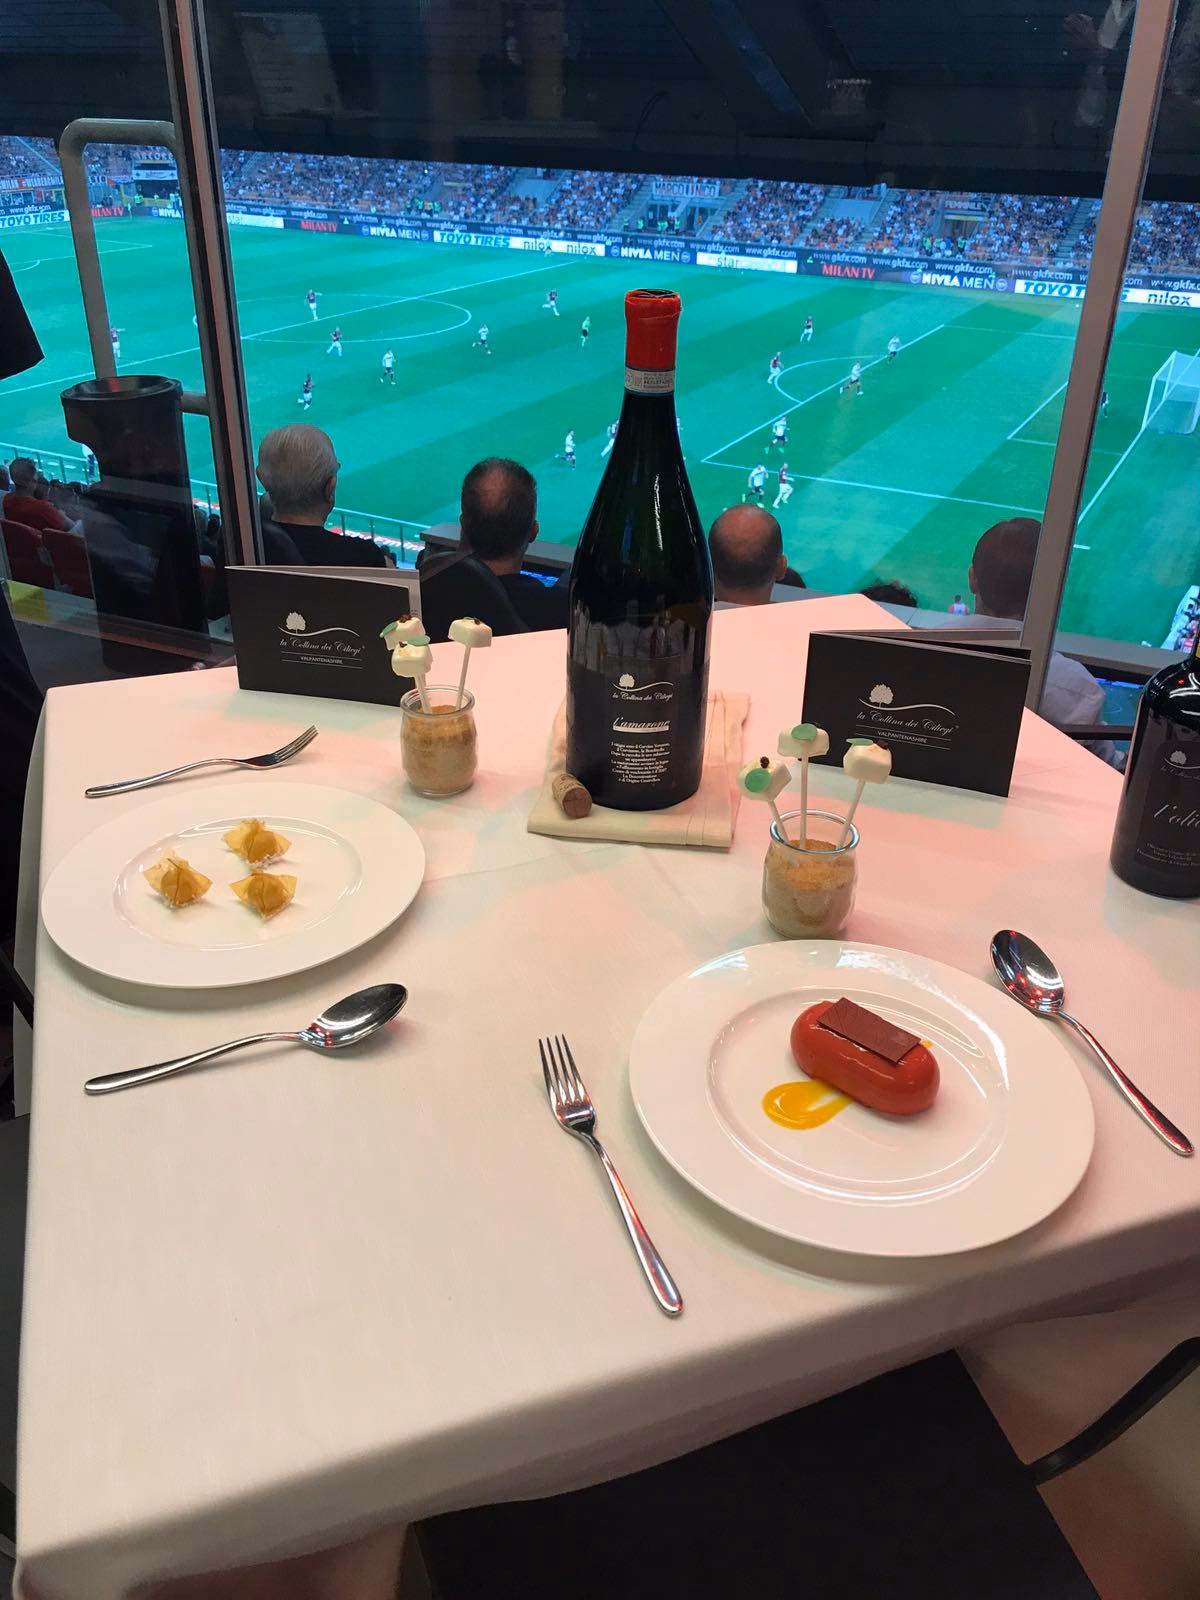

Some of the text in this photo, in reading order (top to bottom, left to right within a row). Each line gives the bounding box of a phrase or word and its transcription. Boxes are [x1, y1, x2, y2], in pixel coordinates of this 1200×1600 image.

[0, 212, 65, 227] TOYO TIRES
[369, 225, 421, 239] NIVEA MEN
[439, 231, 510, 248] TOYO TIRES
[566, 243, 597, 256] nilox
[620, 246, 680, 261] NIVEA MEN
[745, 246, 796, 258] www.gkfx.com
[813, 252, 867, 264] www.gkfx.com
[872, 257, 928, 269] www.gkfx.com
[822, 263, 876, 279] MILAN TV
[935, 262, 993, 274] www.gkfx.com
[1011, 268, 1073, 280] www.gkfx.com
[921, 272, 995, 290] NIVEA MEN
[1023, 281, 1072, 297] TOYO
[1147, 291, 1192, 306] nilox
[279, 638, 288, 646] la
[289, 636, 320, 649] Collina
[320, 643, 332, 651] dei
[856, 711, 866, 720] la
[869, 710, 903, 726] Collina
[904, 719, 919, 728] dei
